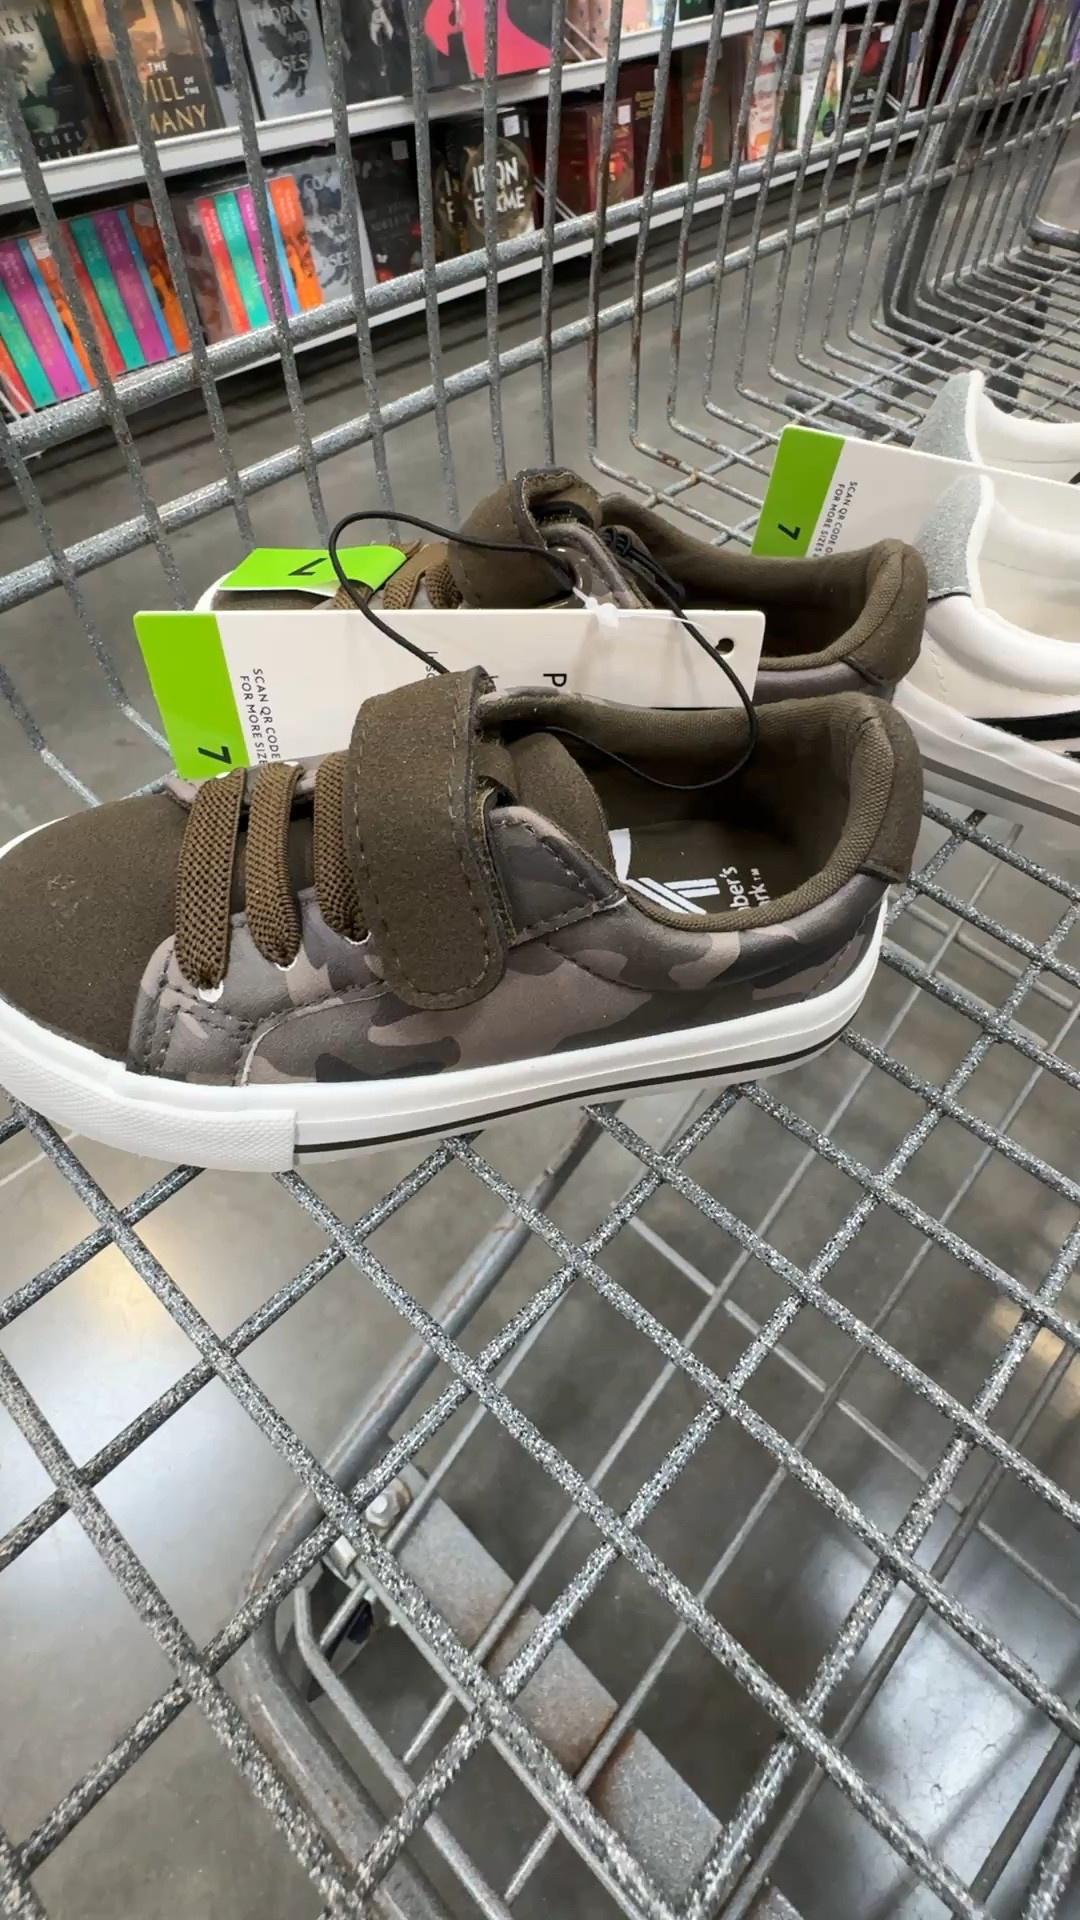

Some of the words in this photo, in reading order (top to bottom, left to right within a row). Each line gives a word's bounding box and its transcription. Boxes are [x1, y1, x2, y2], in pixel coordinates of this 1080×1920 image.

[147, 61, 168, 73] THE
[474, 186, 525, 219] FAME
[832, 483, 846, 502] FOR
[843, 481, 858, 507] SCAN
[823, 504, 837, 528] MORE
[837, 507, 848, 521] QR
[777, 523, 801, 541] 7
[828, 522, 843, 545] CODE
[287, 557, 329, 577] 7
[240, 675, 254, 701] FOR
[253, 668, 269, 703] SCAN
[246, 704, 263, 739] MORE
[260, 706, 274, 724] QR
[254, 742, 269, 765] SIZE
[266, 727, 281, 759] CODE
[197, 745, 232, 765] 7
[719, 866, 750, 911] ber's
